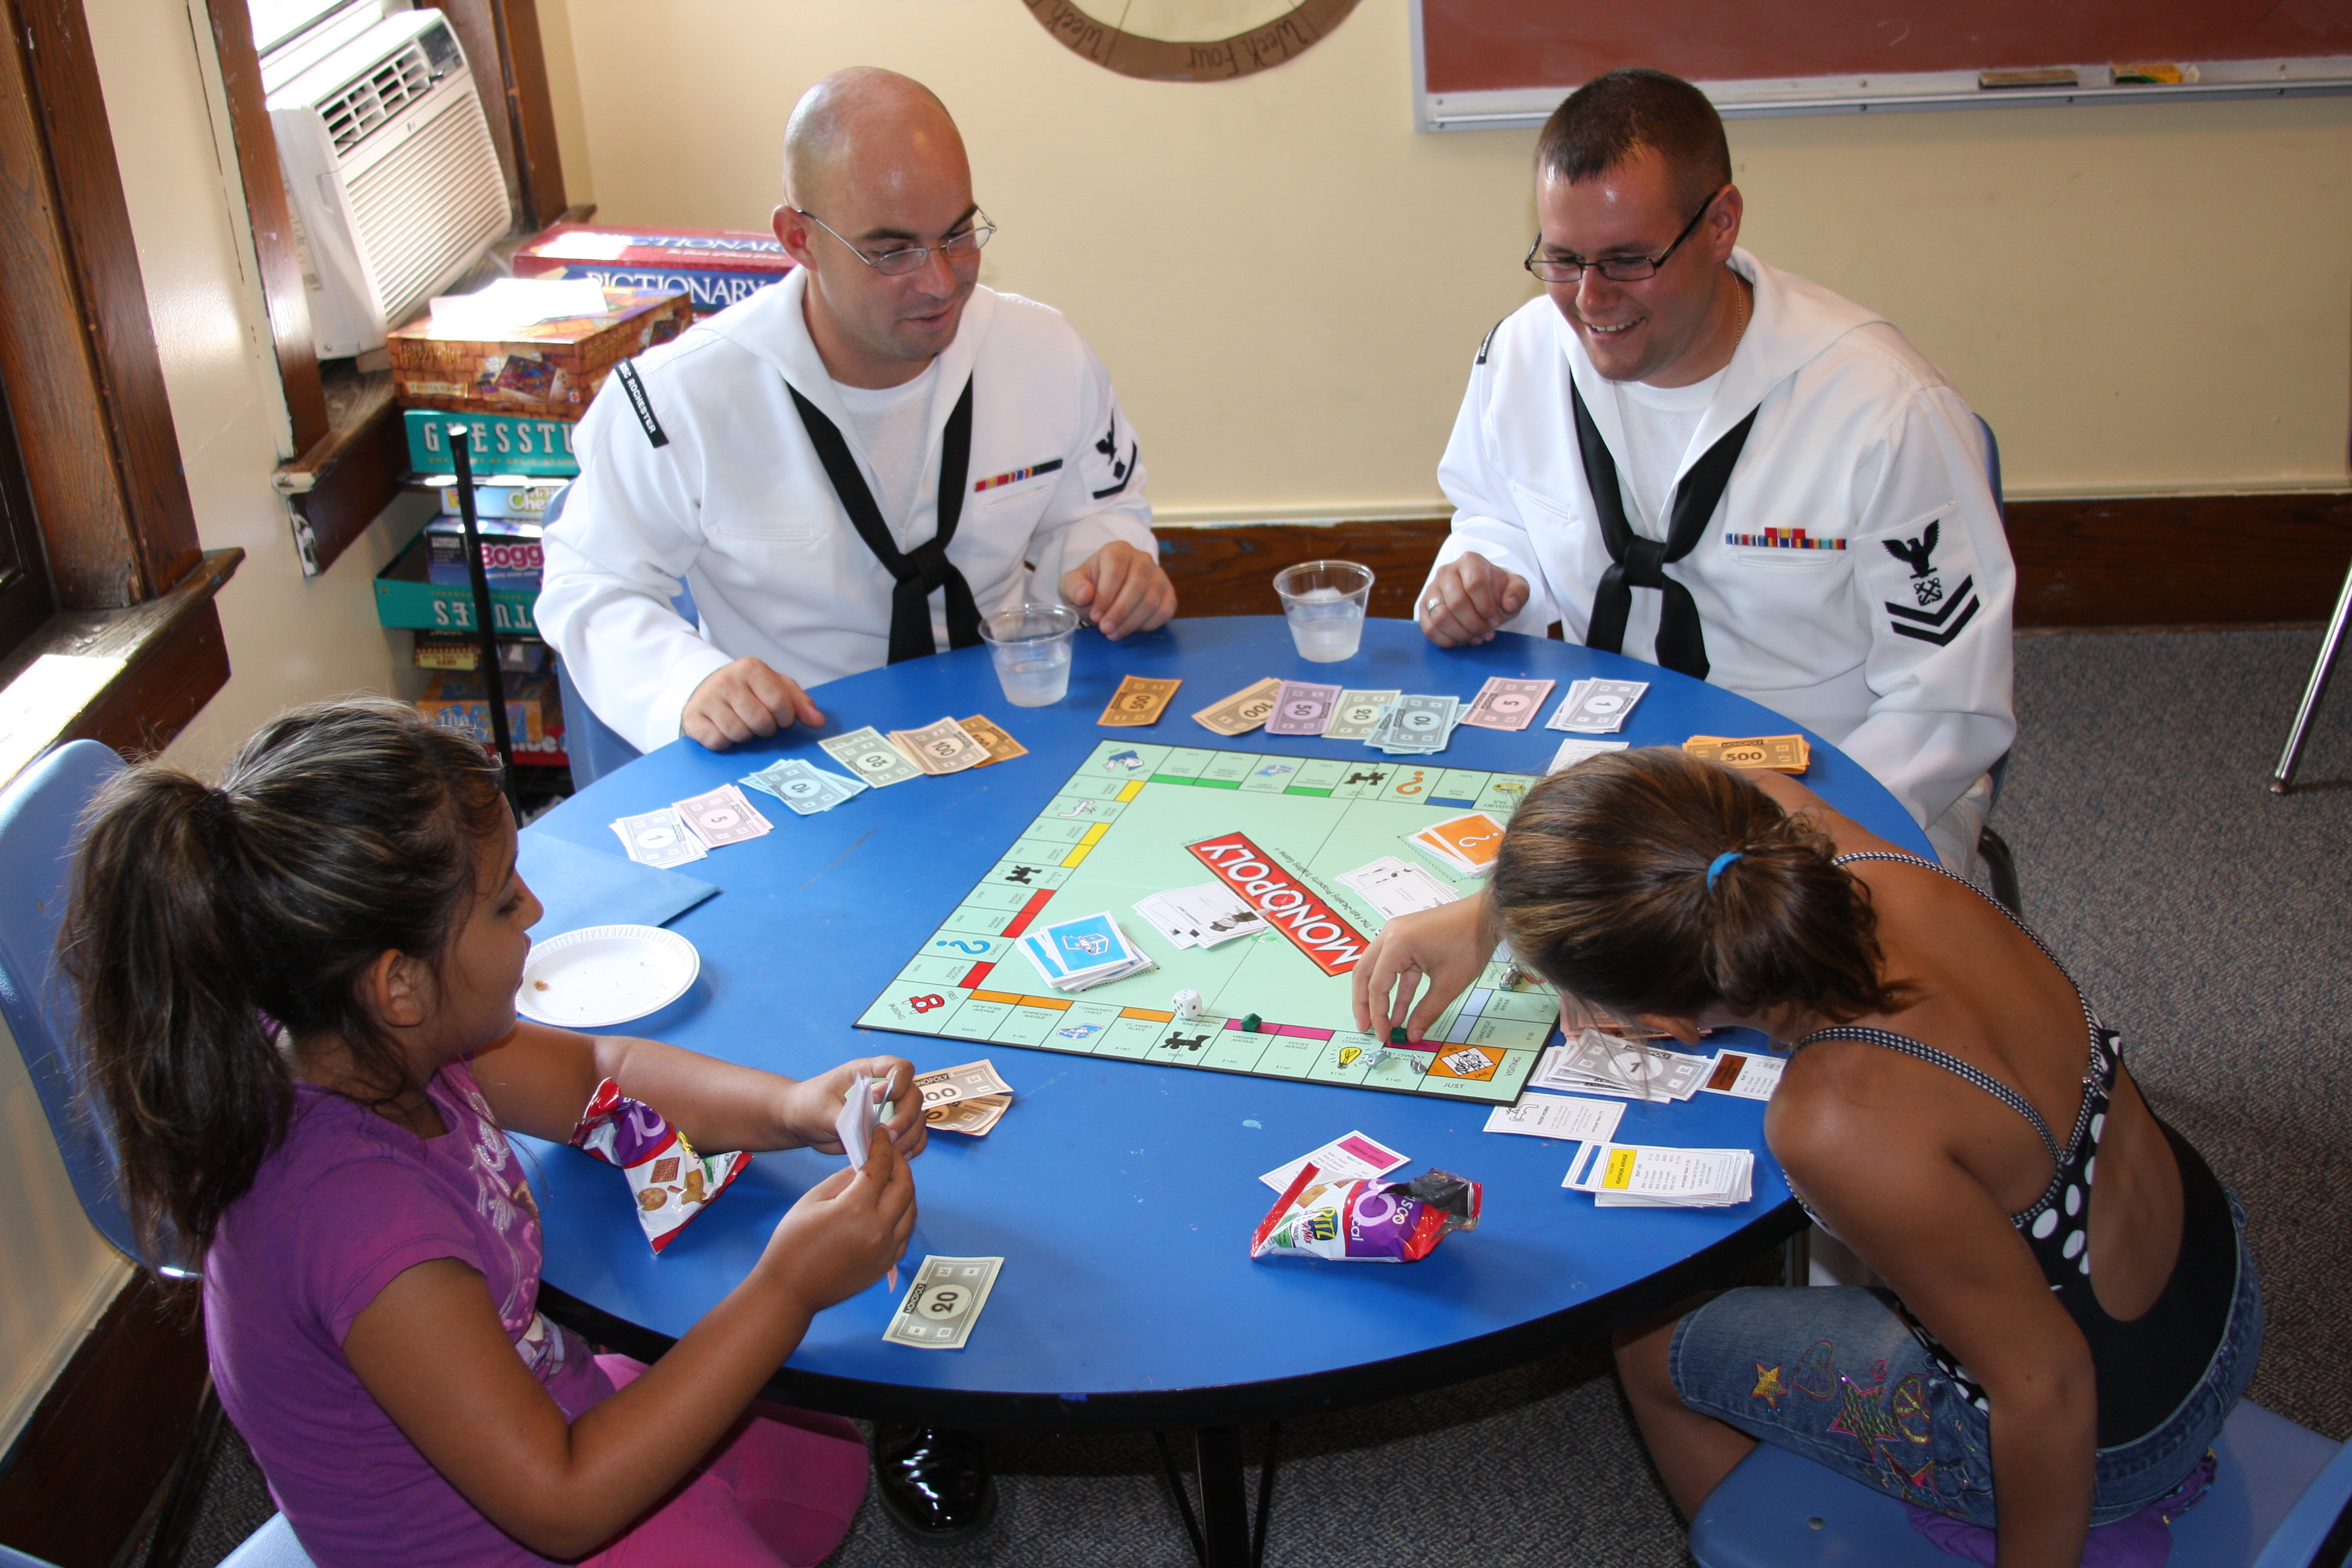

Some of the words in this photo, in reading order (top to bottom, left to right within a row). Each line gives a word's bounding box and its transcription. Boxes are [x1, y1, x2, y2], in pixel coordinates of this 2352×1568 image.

[1241, 19, 1308, 67] Week
[627, 378, 656, 434] ROCHESTER
[1129, 695, 1150, 710] 500
[1244, 702, 1273, 717] 100
[1294, 704, 1312, 716] 50
[1353, 708, 1371, 720] 20
[1413, 716, 1431, 727] 10
[932, 741, 956, 756] 100
[865, 755, 890, 768] 20
[1725, 752, 1762, 762] 500
[791, 783, 812, 793] 10
[1279, 850, 1294, 864] Game
[1293, 861, 1312, 878] Trading
[1309, 876, 1332, 895] Property
[1200, 844, 1361, 967] MONOPOLY
[1361, 918, 1372, 929] The
[946, 990, 959, 1001] FREE
[888, 1002, 906, 1021] PARKING
[1476, 1020, 1492, 1043] CONNECTICUT
[1486, 1025, 1497, 1039] AVENUE
[1504, 1056, 1521, 1077] VISITING
[1630, 1062, 1641, 1073] 1
[1474, 1071, 1491, 1079] JAIL
[926, 1088, 956, 1101] 00
[1313, 1207, 1338, 1240] RITZ
[1302, 1230, 1315, 1244] Mix
[906, 1284, 925, 1313] MONOPOLY
[932, 1292, 958, 1313] 20
